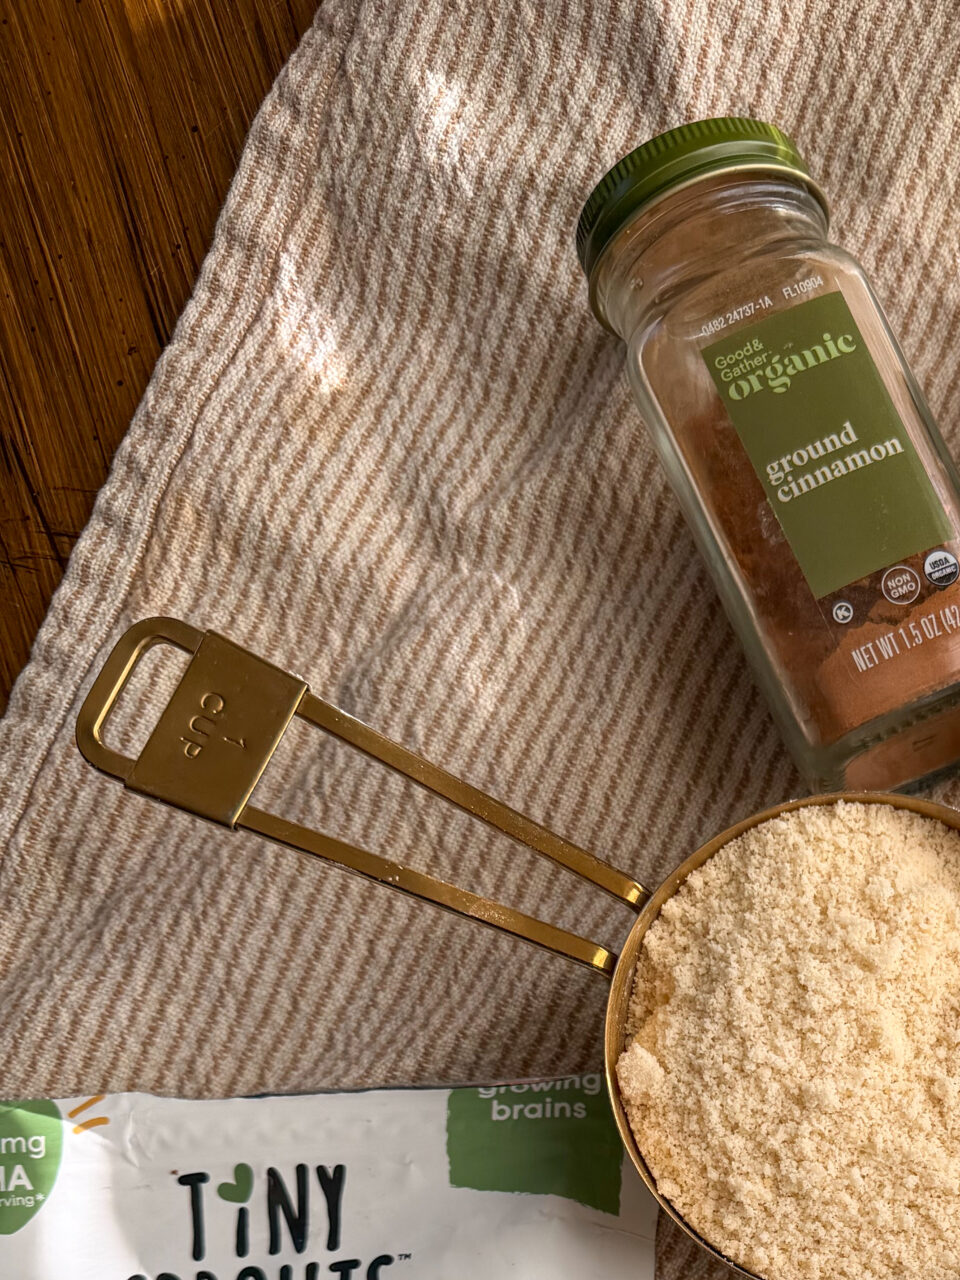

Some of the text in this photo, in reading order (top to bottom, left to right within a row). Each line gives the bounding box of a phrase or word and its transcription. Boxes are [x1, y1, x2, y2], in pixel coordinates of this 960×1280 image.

[726, 295, 774, 324] 24737-1A
[782, 275, 824, 299] FL10904
[720, 351, 769, 382] Gather
[728, 333, 857, 401] organic
[766, 420, 859, 486] ground
[777, 437, 905, 503] cinnamon
[887, 573, 912, 589] NON
[929, 557, 950, 571] USDA
[890, 582, 916, 599] GMO
[851, 642, 879, 673] NET
[876, 632, 900, 660] WT
[899, 622, 923, 649] 1.5
[920, 613, 943, 640] OZ
[179, 691, 225, 760] CUP
[491, 1098, 587, 1121] brains
[1, 1135, 46, 1159] mg
